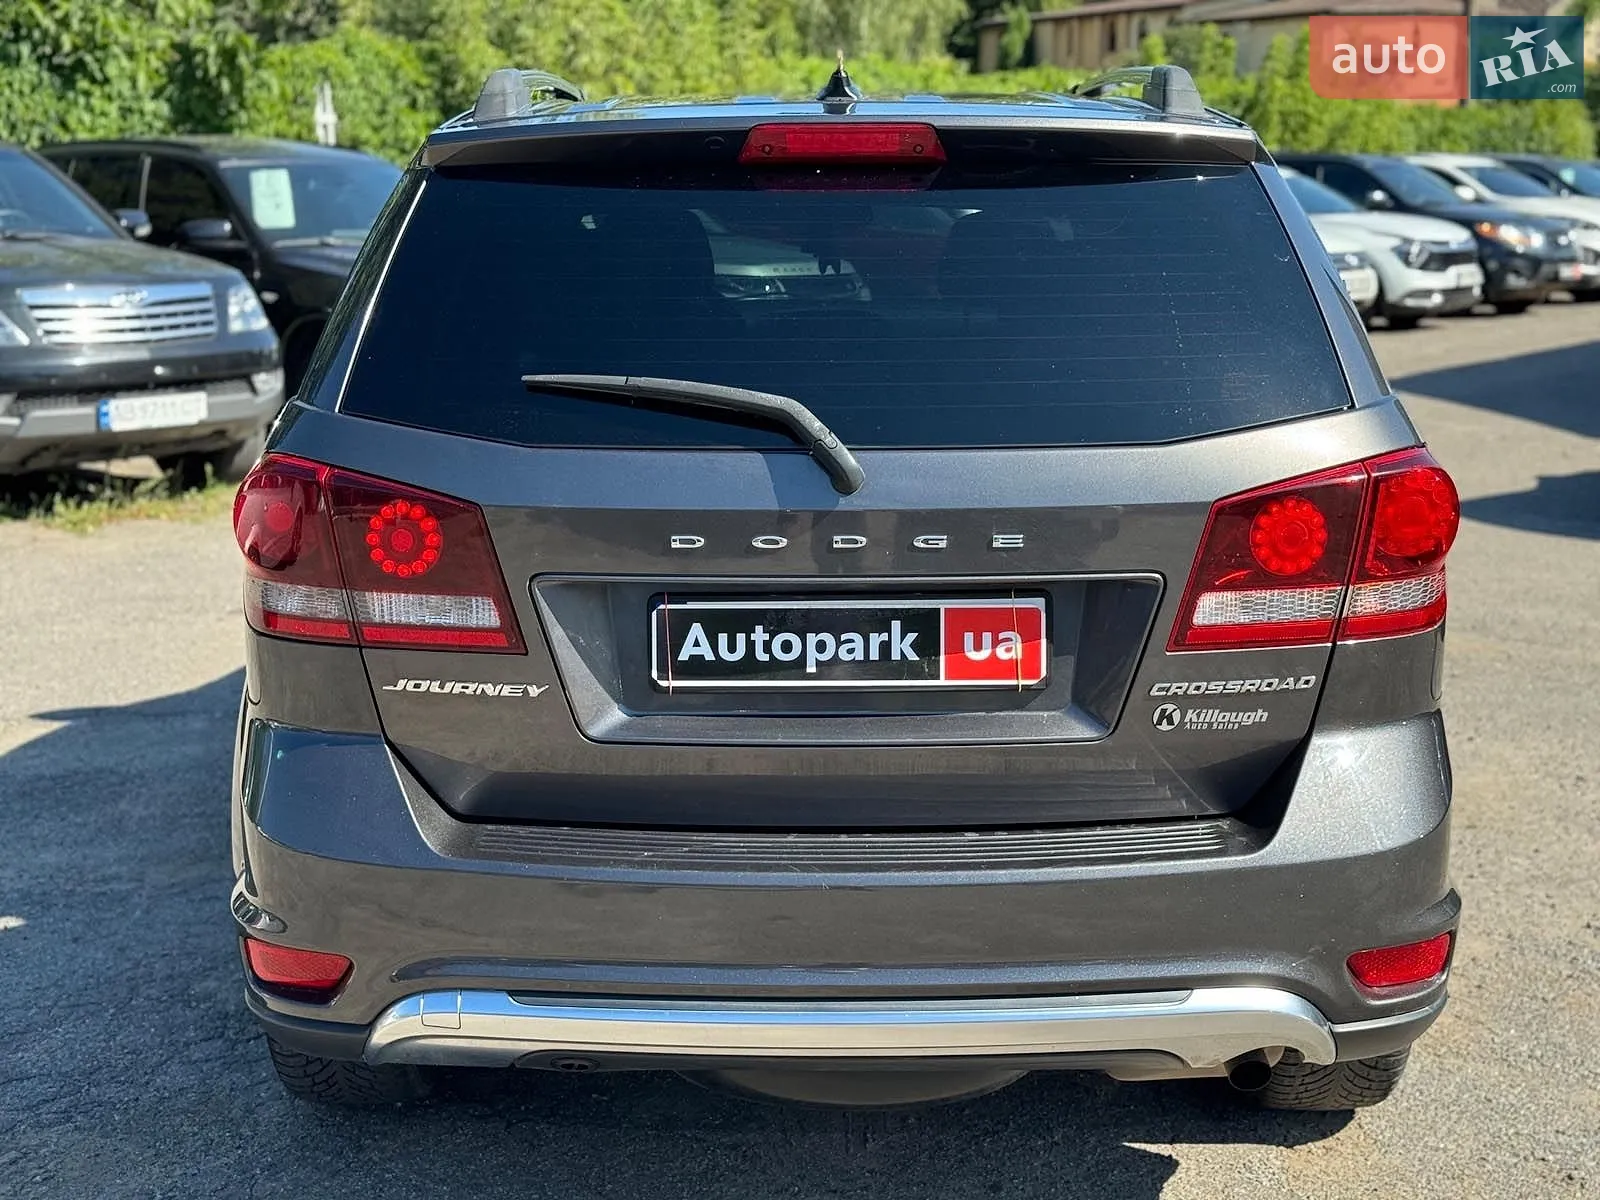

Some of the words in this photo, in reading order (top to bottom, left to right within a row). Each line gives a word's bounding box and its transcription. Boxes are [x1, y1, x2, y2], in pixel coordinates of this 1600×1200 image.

[670, 534, 1024, 549] DODGE
[677, 620, 920, 673] Autopark
[963, 631, 1024, 661] ua
[382, 679, 550, 698] JOURNEY
[1149, 675, 1316, 697] CROSSROAD
[1184, 708, 1269, 726] Killough
